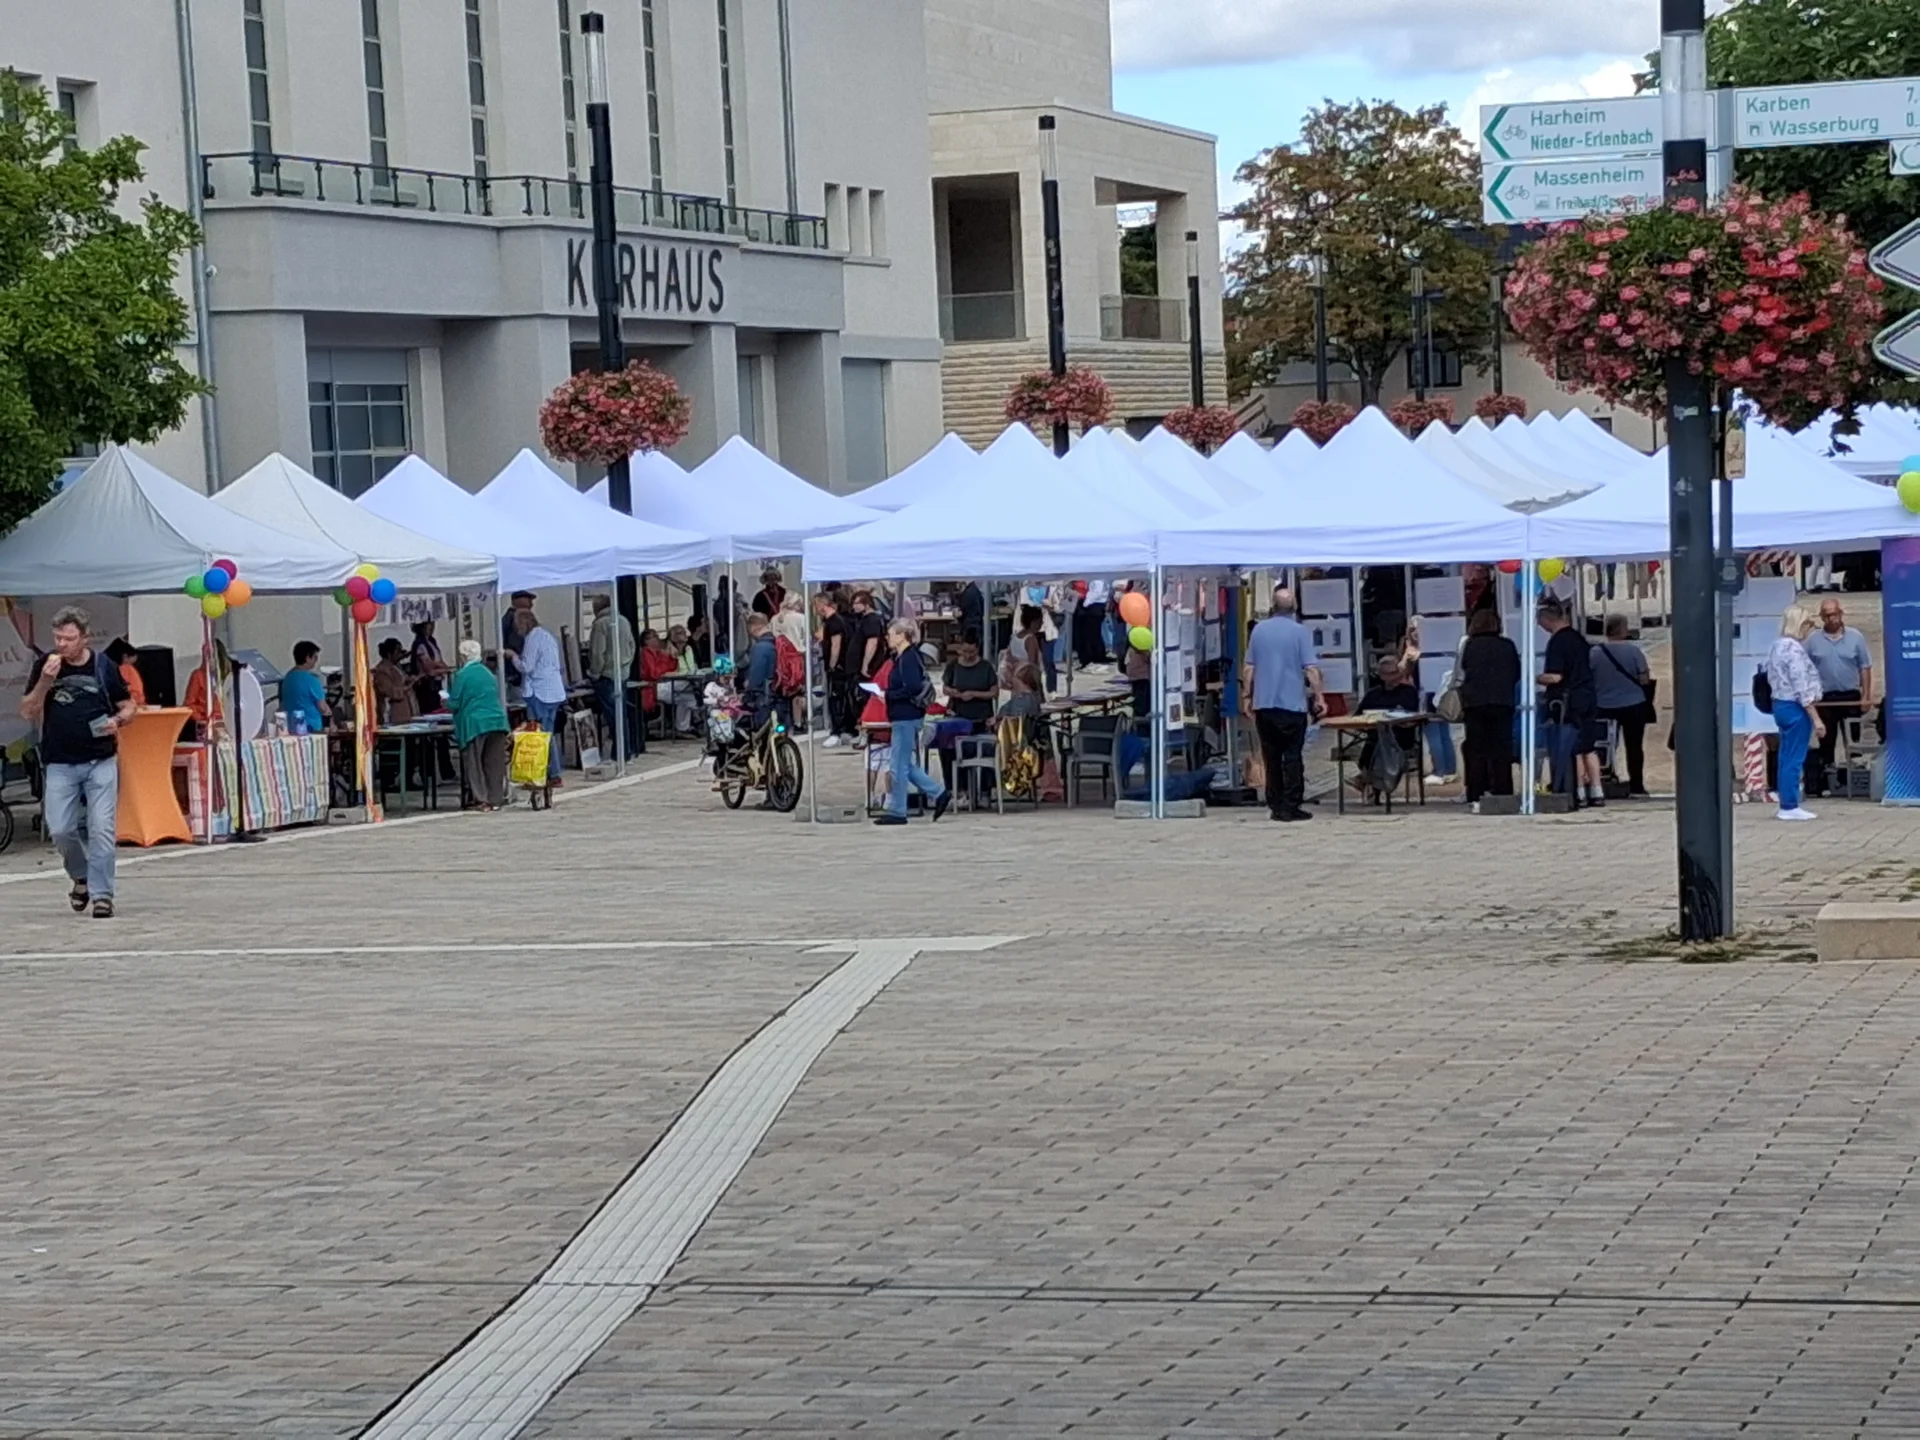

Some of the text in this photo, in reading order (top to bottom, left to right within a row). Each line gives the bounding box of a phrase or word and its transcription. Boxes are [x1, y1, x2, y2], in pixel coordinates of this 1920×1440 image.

[1746, 96, 1811, 113] Karben
[1530, 108, 1606, 126] Harheim
[1769, 116, 1879, 136] Wasserburg
[1530, 128, 1653, 150] Nieder-Erlenbach
[1534, 166, 1645, 187] Massenheim
[567, 237, 724, 313] KRHAUS
